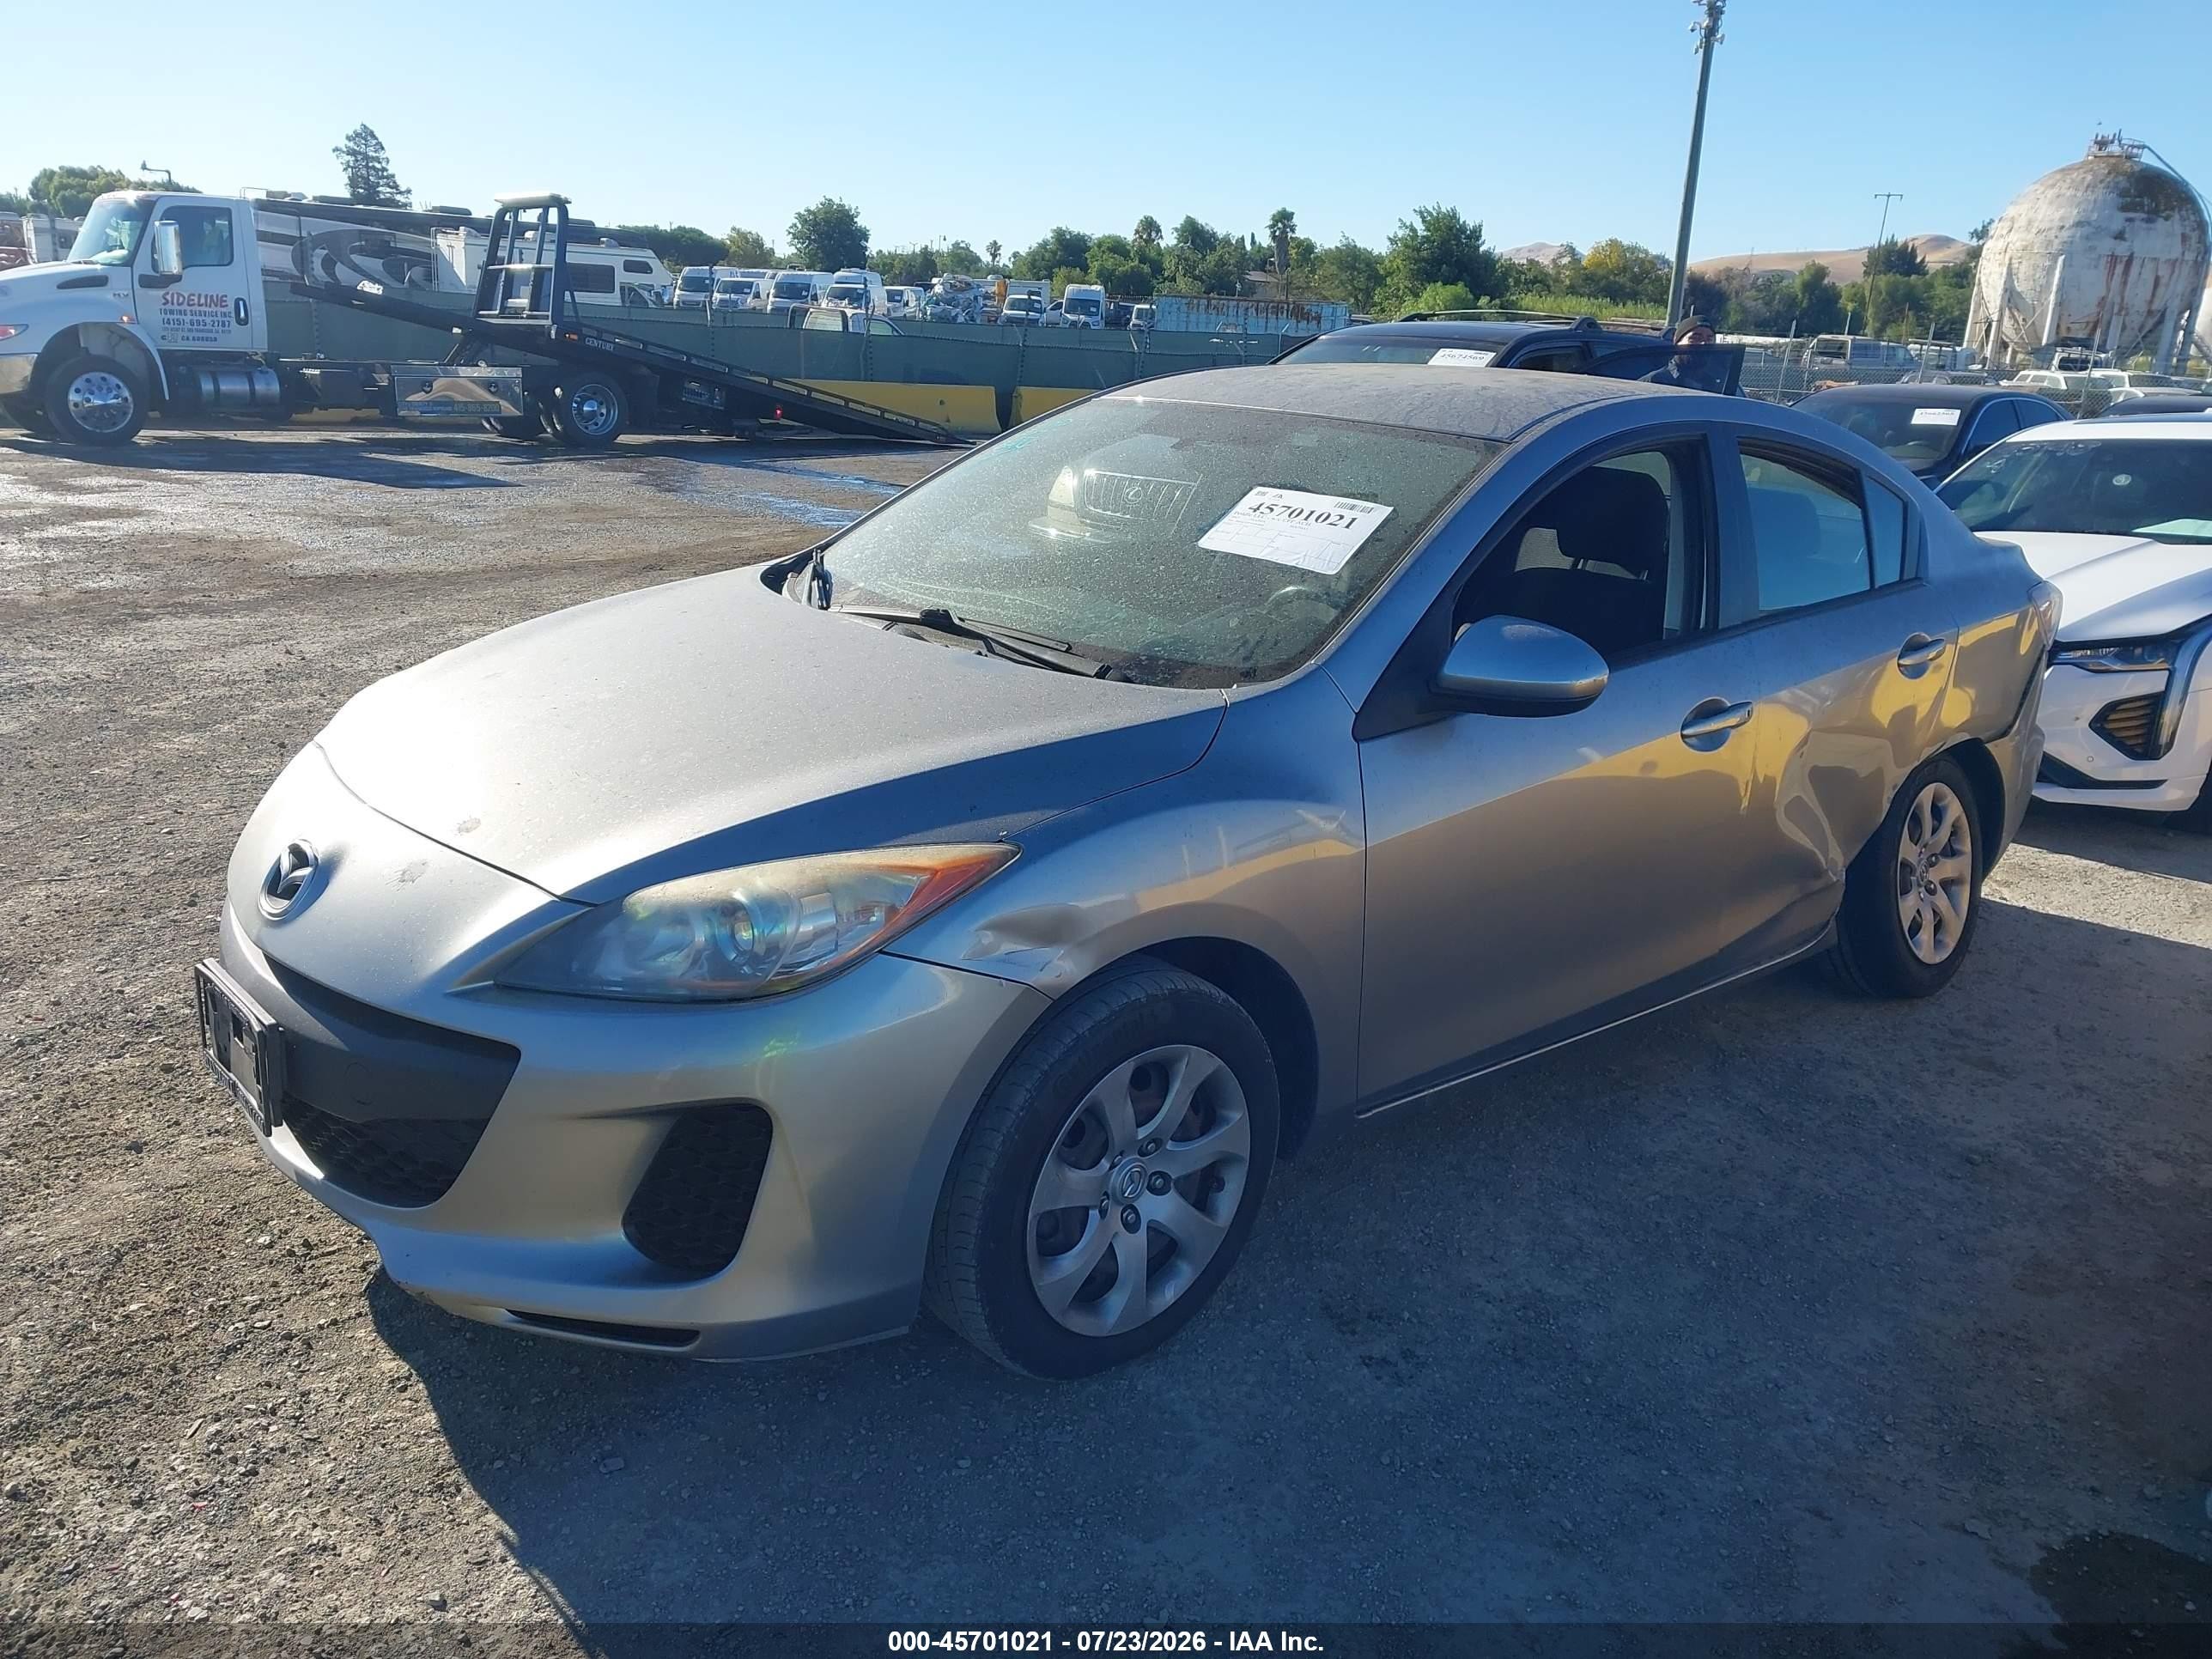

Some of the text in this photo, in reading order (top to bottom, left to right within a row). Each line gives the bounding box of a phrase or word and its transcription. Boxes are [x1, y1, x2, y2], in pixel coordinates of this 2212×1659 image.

[161, 291, 229, 308] SIDELINE
[159, 308, 188, 317] TOWING
[189, 309, 219, 318] SERVICE
[161, 318, 231, 328] (415)-695-2787
[1248, 501, 1360, 530] 45701021
